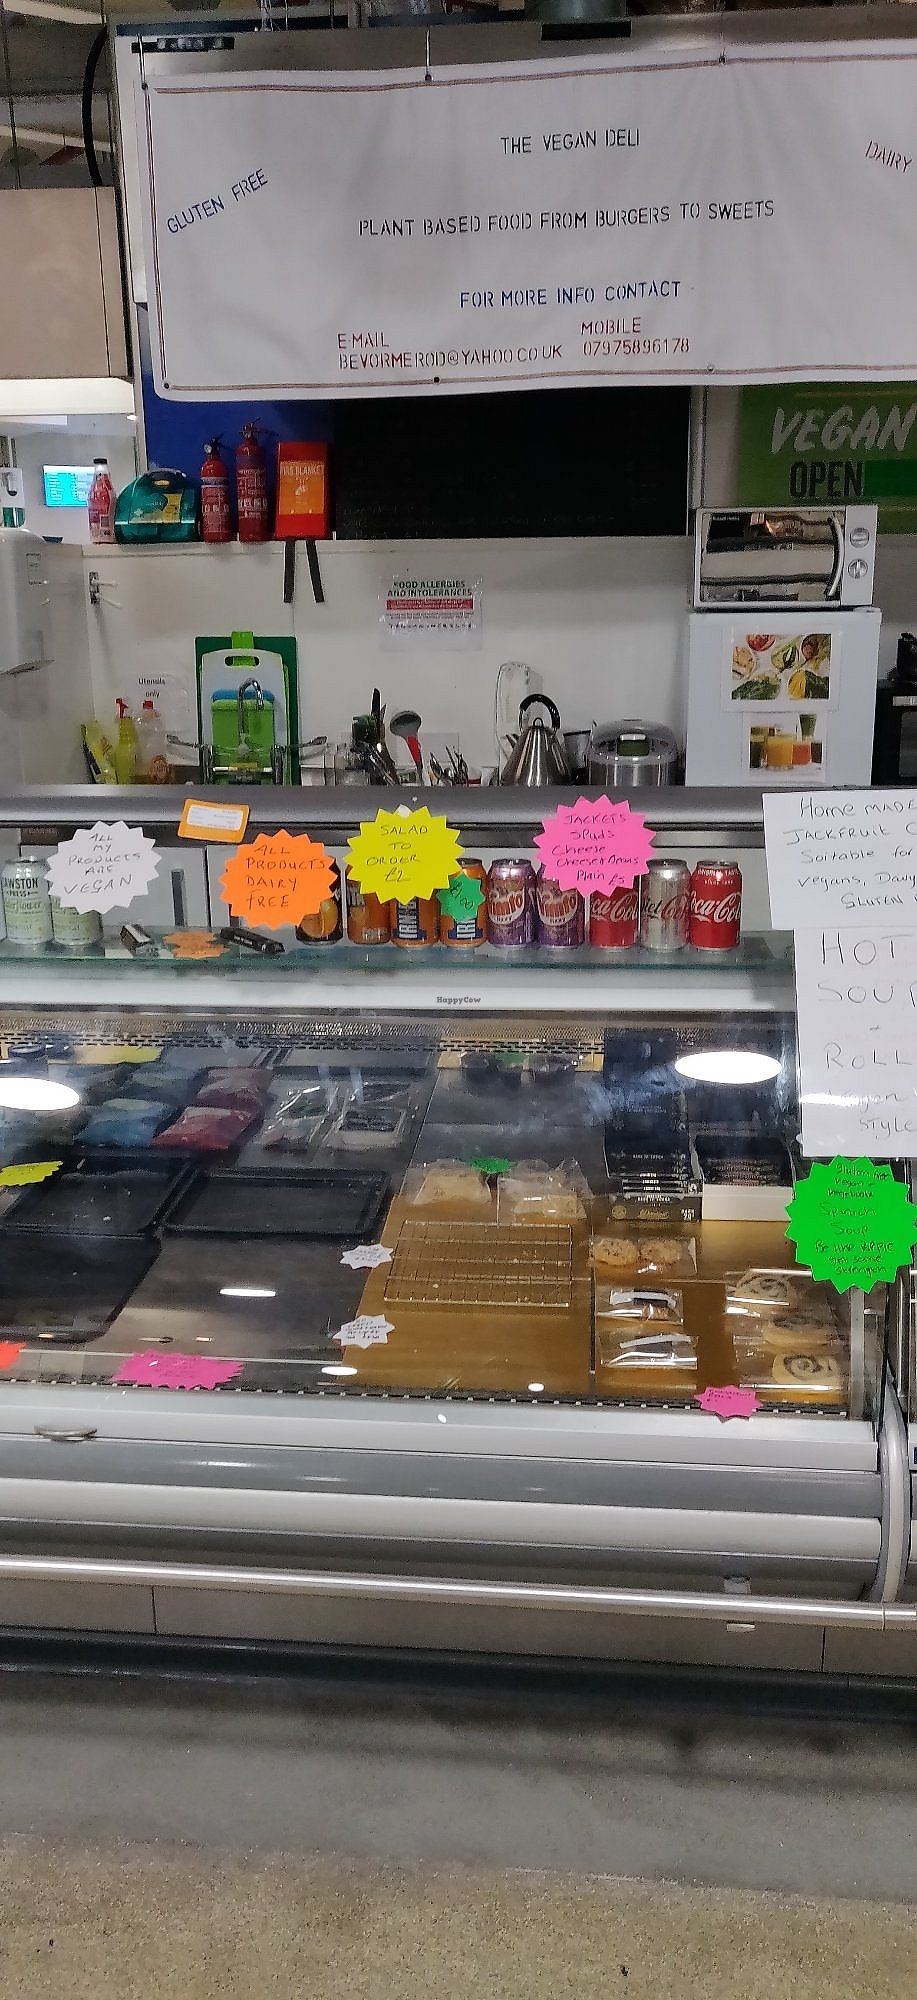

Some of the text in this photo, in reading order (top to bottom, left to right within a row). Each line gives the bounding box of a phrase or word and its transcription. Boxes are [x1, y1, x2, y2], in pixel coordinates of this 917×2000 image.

[500, 127, 640, 154] THE VEGAN DELI
[865, 139, 912, 173] DAIRY
[166, 168, 270, 235] GLUTEN FREE
[358, 200, 775, 236] PLANT BASED FOOD FROM BURGERS TO SWEETS
[460, 280, 682, 308] FOR MORE INFO CONTACT
[580, 317, 642, 336] MOBILE
[582, 337, 691, 357] 07975896178
[769, 402, 917, 455] VEGAN
[789, 460, 864, 498] OPEN
[393, 580, 465, 588] FOOD ALLERGIES
[408, 588, 472, 597] INTOLERANCES
[138, 677, 165, 685] Utensils
[145, 689, 160, 698] only
[800, 796, 856, 820] Home
[564, 812, 627, 824] JACKETS
[380, 824, 428, 836] SALAD
[89, 833, 113, 842] ALL
[92, 844, 112, 852] MY
[254, 845, 291, 856] ALL
[388, 842, 412, 851] TO
[551, 844, 606, 856] Cheese
[894, 845, 913, 858] for
[68, 852, 142, 866] PRODUCTS
[246, 857, 326, 870] PRODUCTS
[366, 854, 419, 866] ORDER
[85, 865, 113, 876] ARE
[577, 869, 605, 881] Plain
[63, 874, 133, 894] VEGAN
[246, 875, 297, 892] DAIRY
[246, 889, 291, 911] FREE
[822, 932, 913, 966] HOT
[824, 1042, 913, 1070] ROLL
